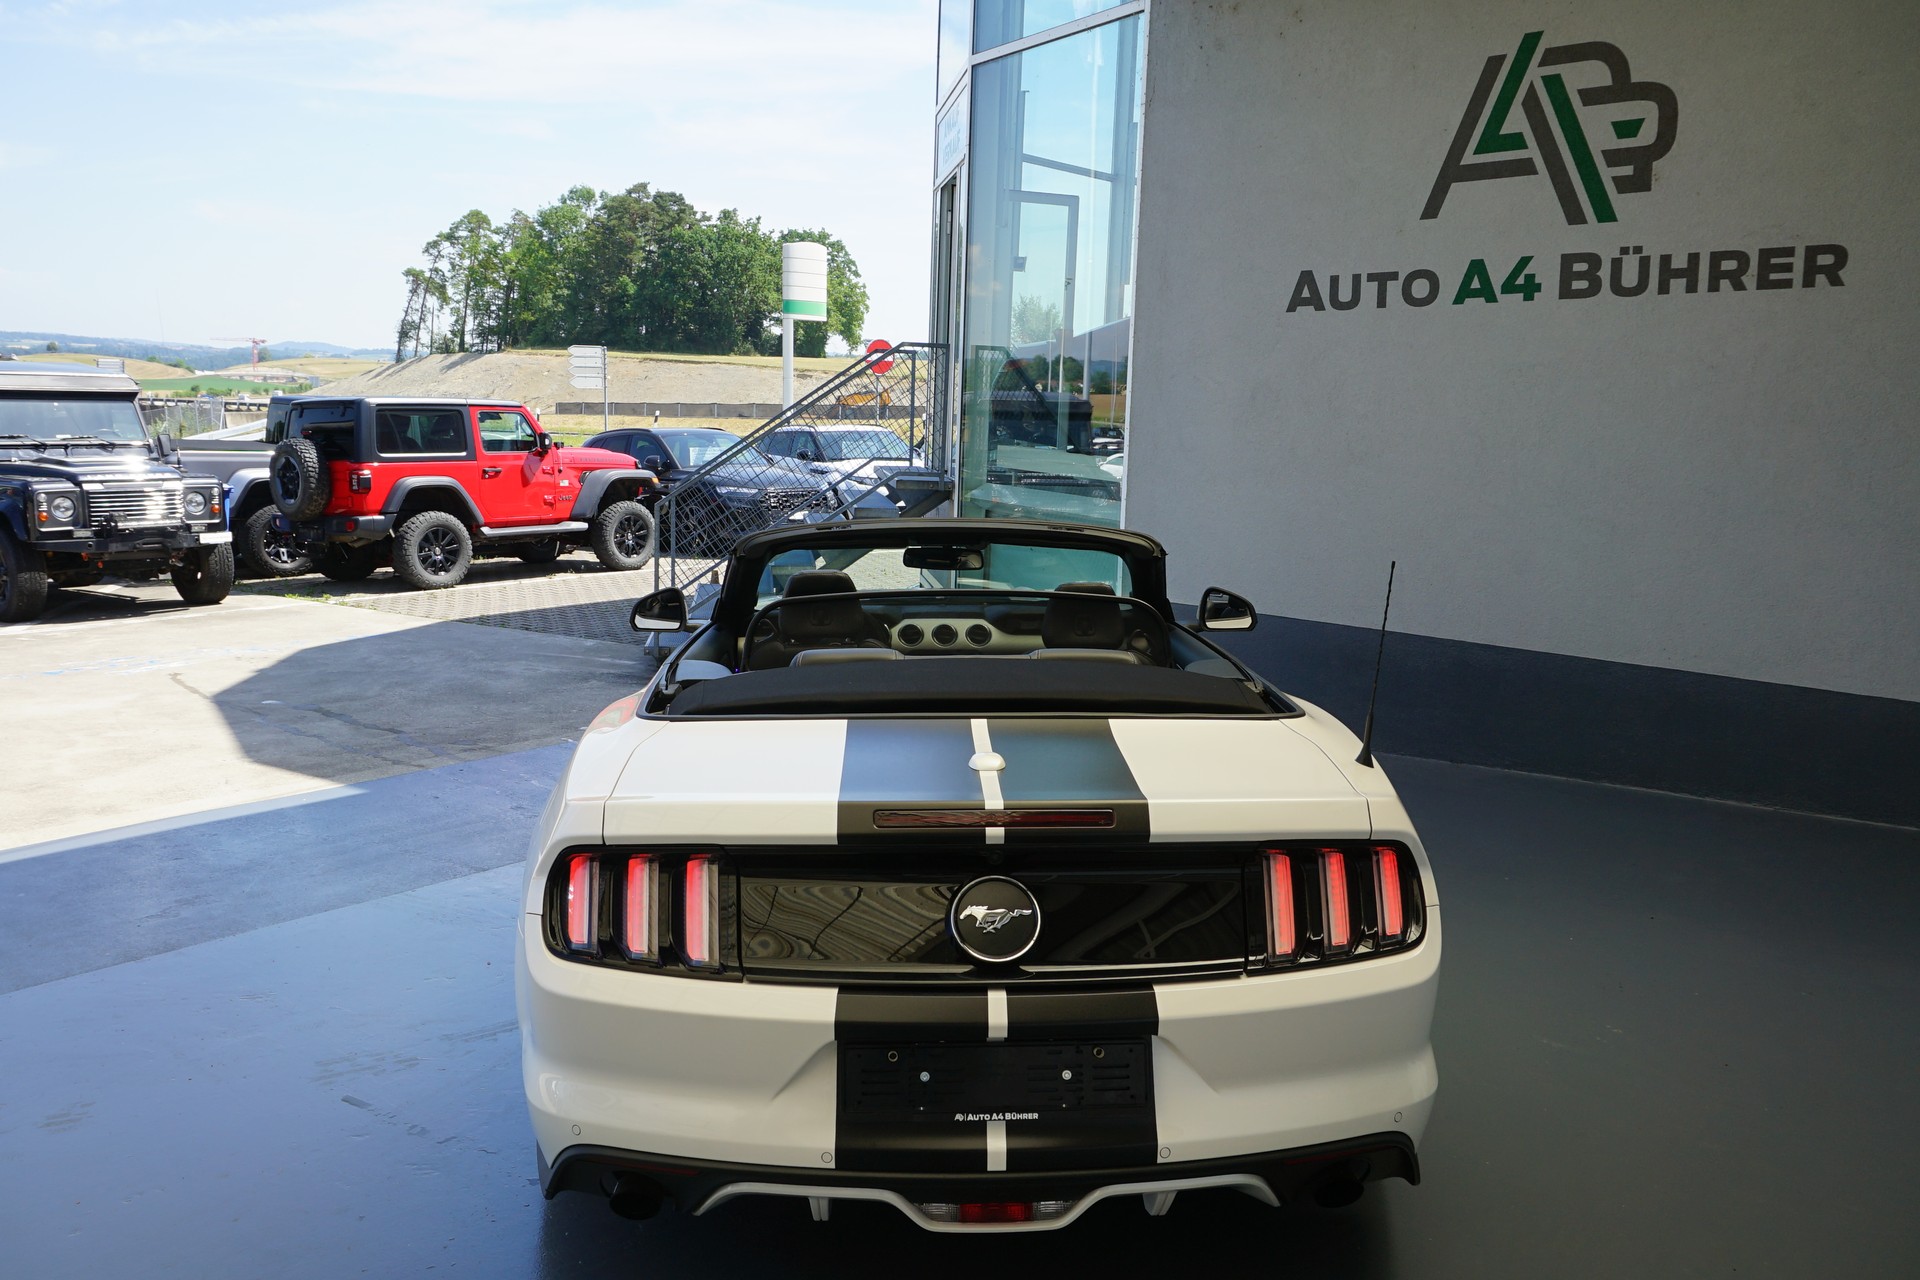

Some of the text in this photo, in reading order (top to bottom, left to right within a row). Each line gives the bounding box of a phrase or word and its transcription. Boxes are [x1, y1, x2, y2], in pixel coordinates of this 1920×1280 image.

[1285, 244, 1850, 313] AUTO A4 BÜHRER
[967, 1113, 991, 1121] AUTO
[991, 1112, 1004, 1121] A4
[1004, 1112, 1039, 1120] BÜHRER
